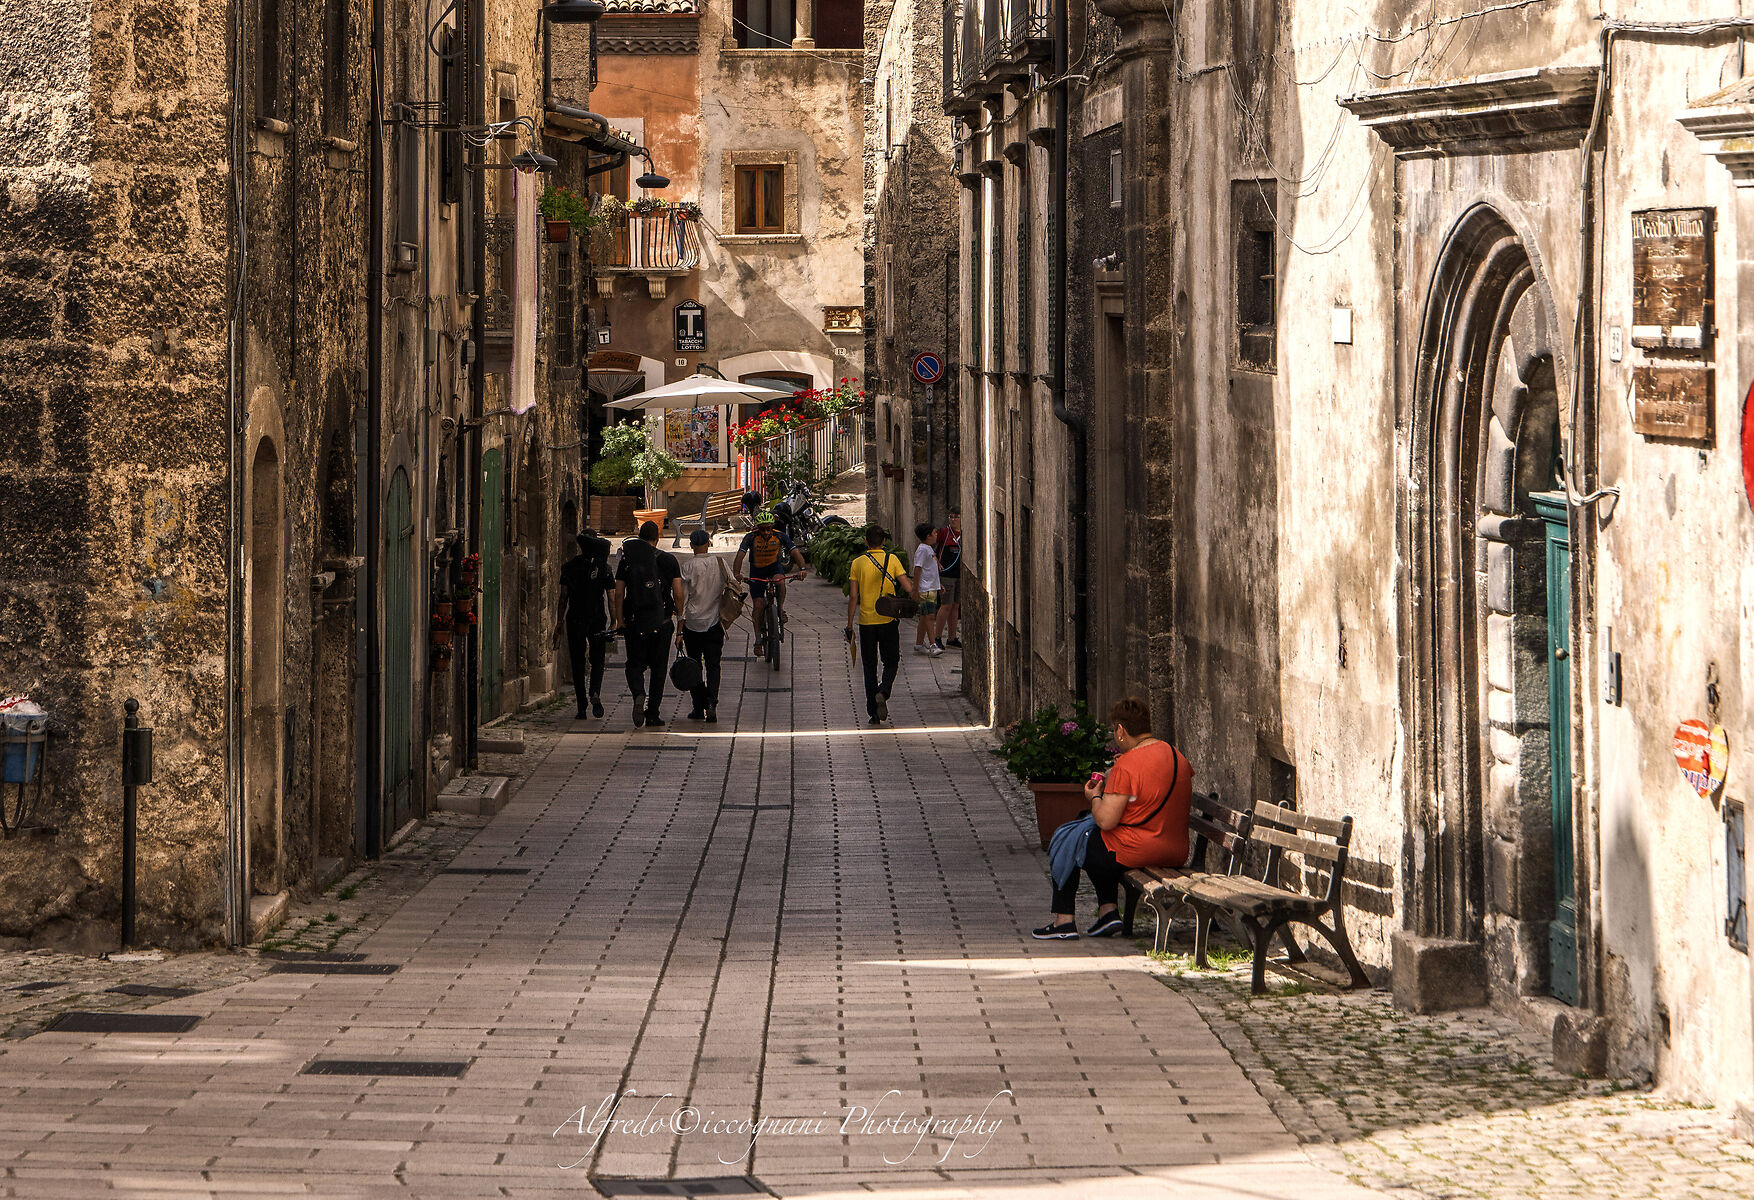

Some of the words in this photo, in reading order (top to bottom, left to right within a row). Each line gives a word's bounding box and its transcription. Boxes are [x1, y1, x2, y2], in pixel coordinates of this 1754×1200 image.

[1639, 216, 1672, 238] Vecchio
[1673, 214, 1704, 237] Mulino
[679, 309, 702, 336] T
